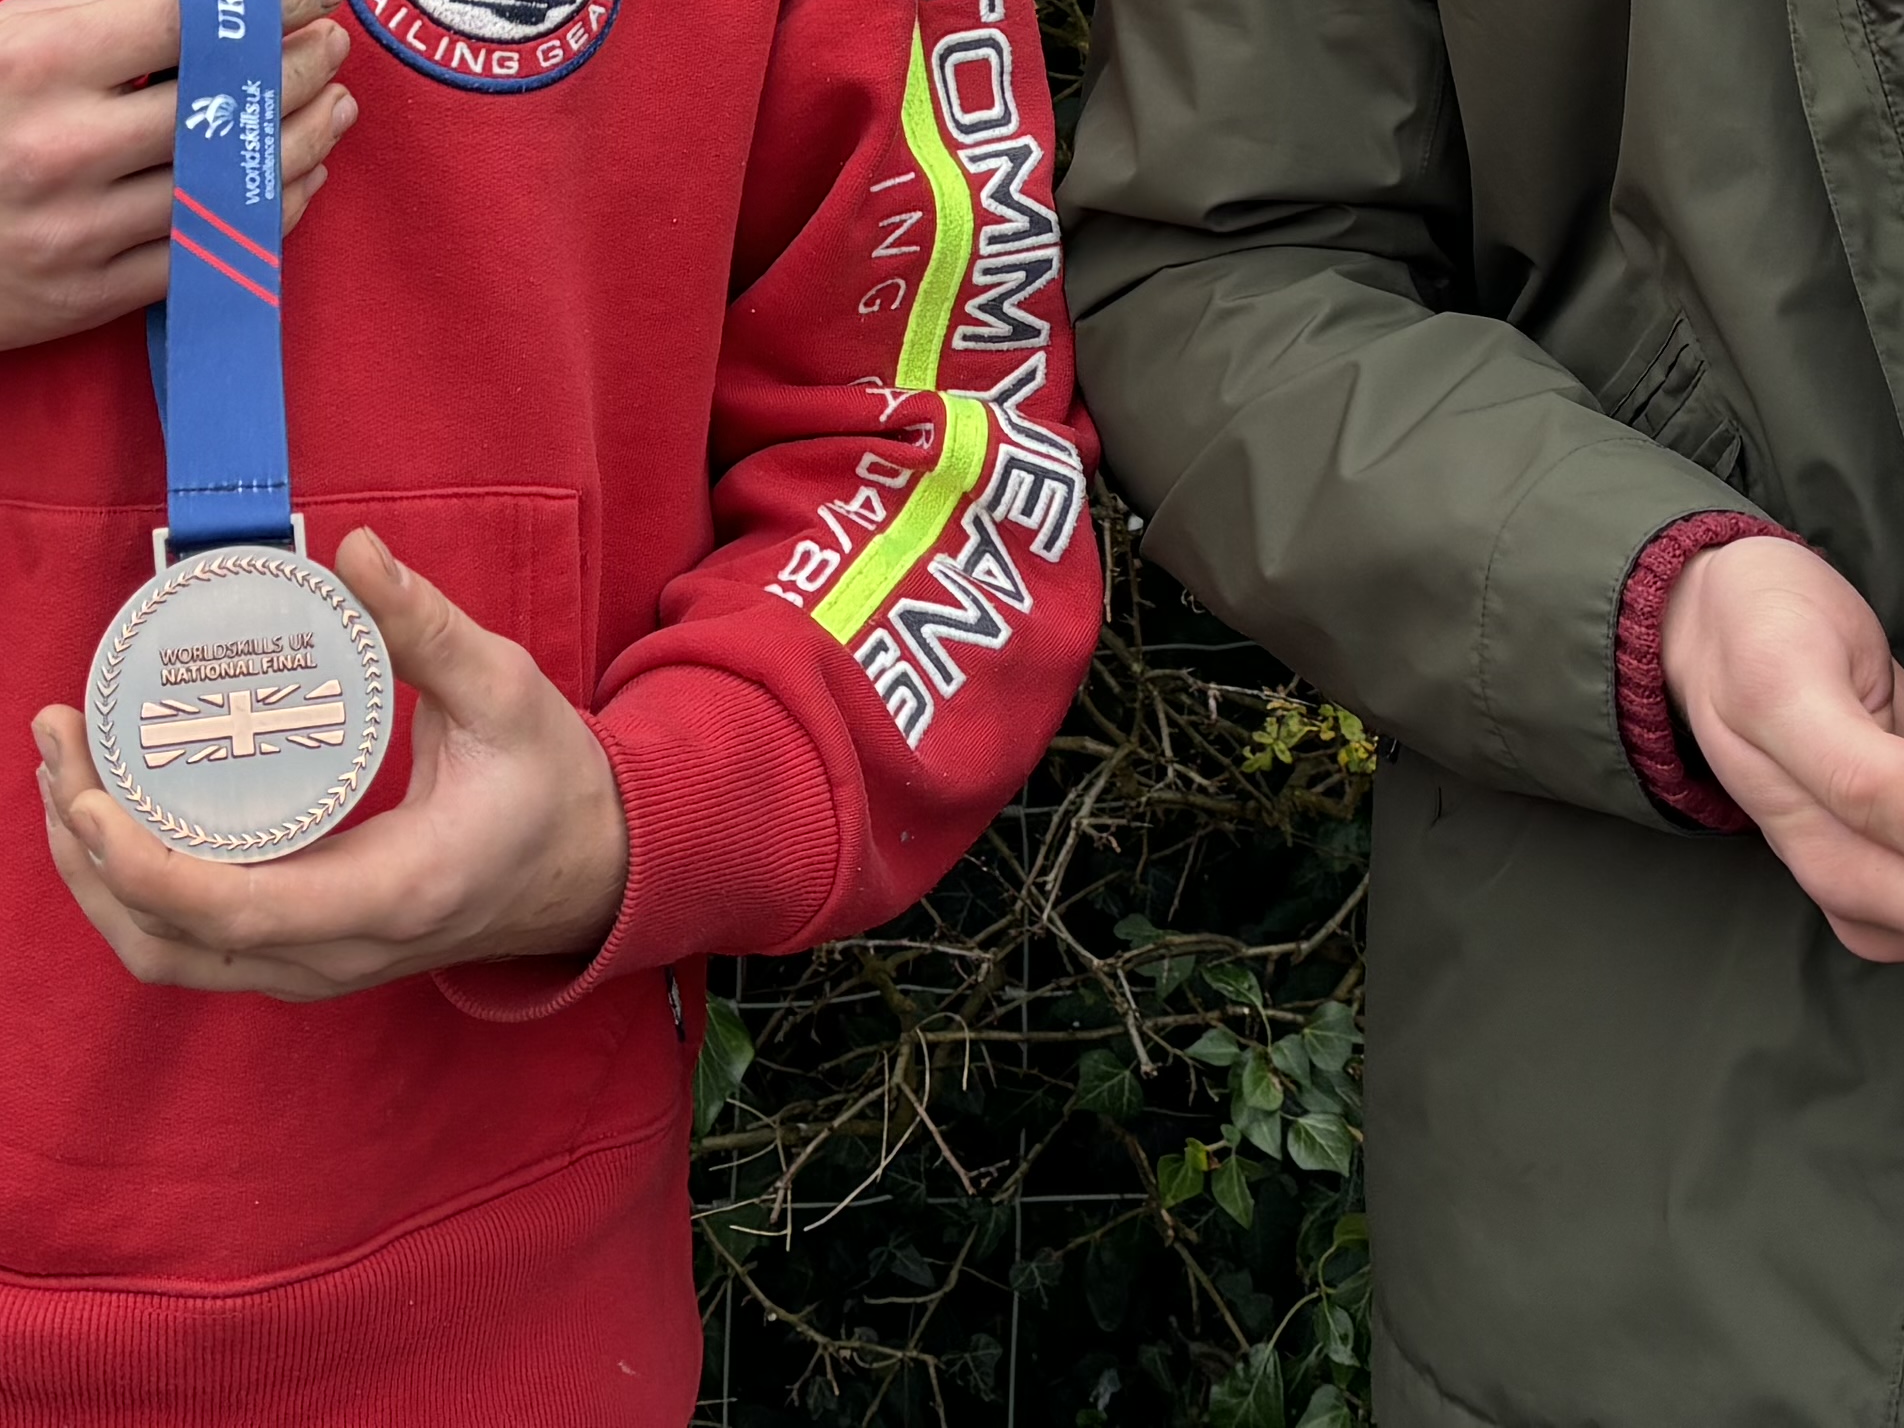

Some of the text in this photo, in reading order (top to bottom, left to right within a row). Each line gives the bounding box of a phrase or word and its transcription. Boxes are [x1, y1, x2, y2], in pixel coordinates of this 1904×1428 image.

[159, 631, 315, 666] WORLDSKILLS UK
[160, 652, 318, 687] NATIONAL FINAL
